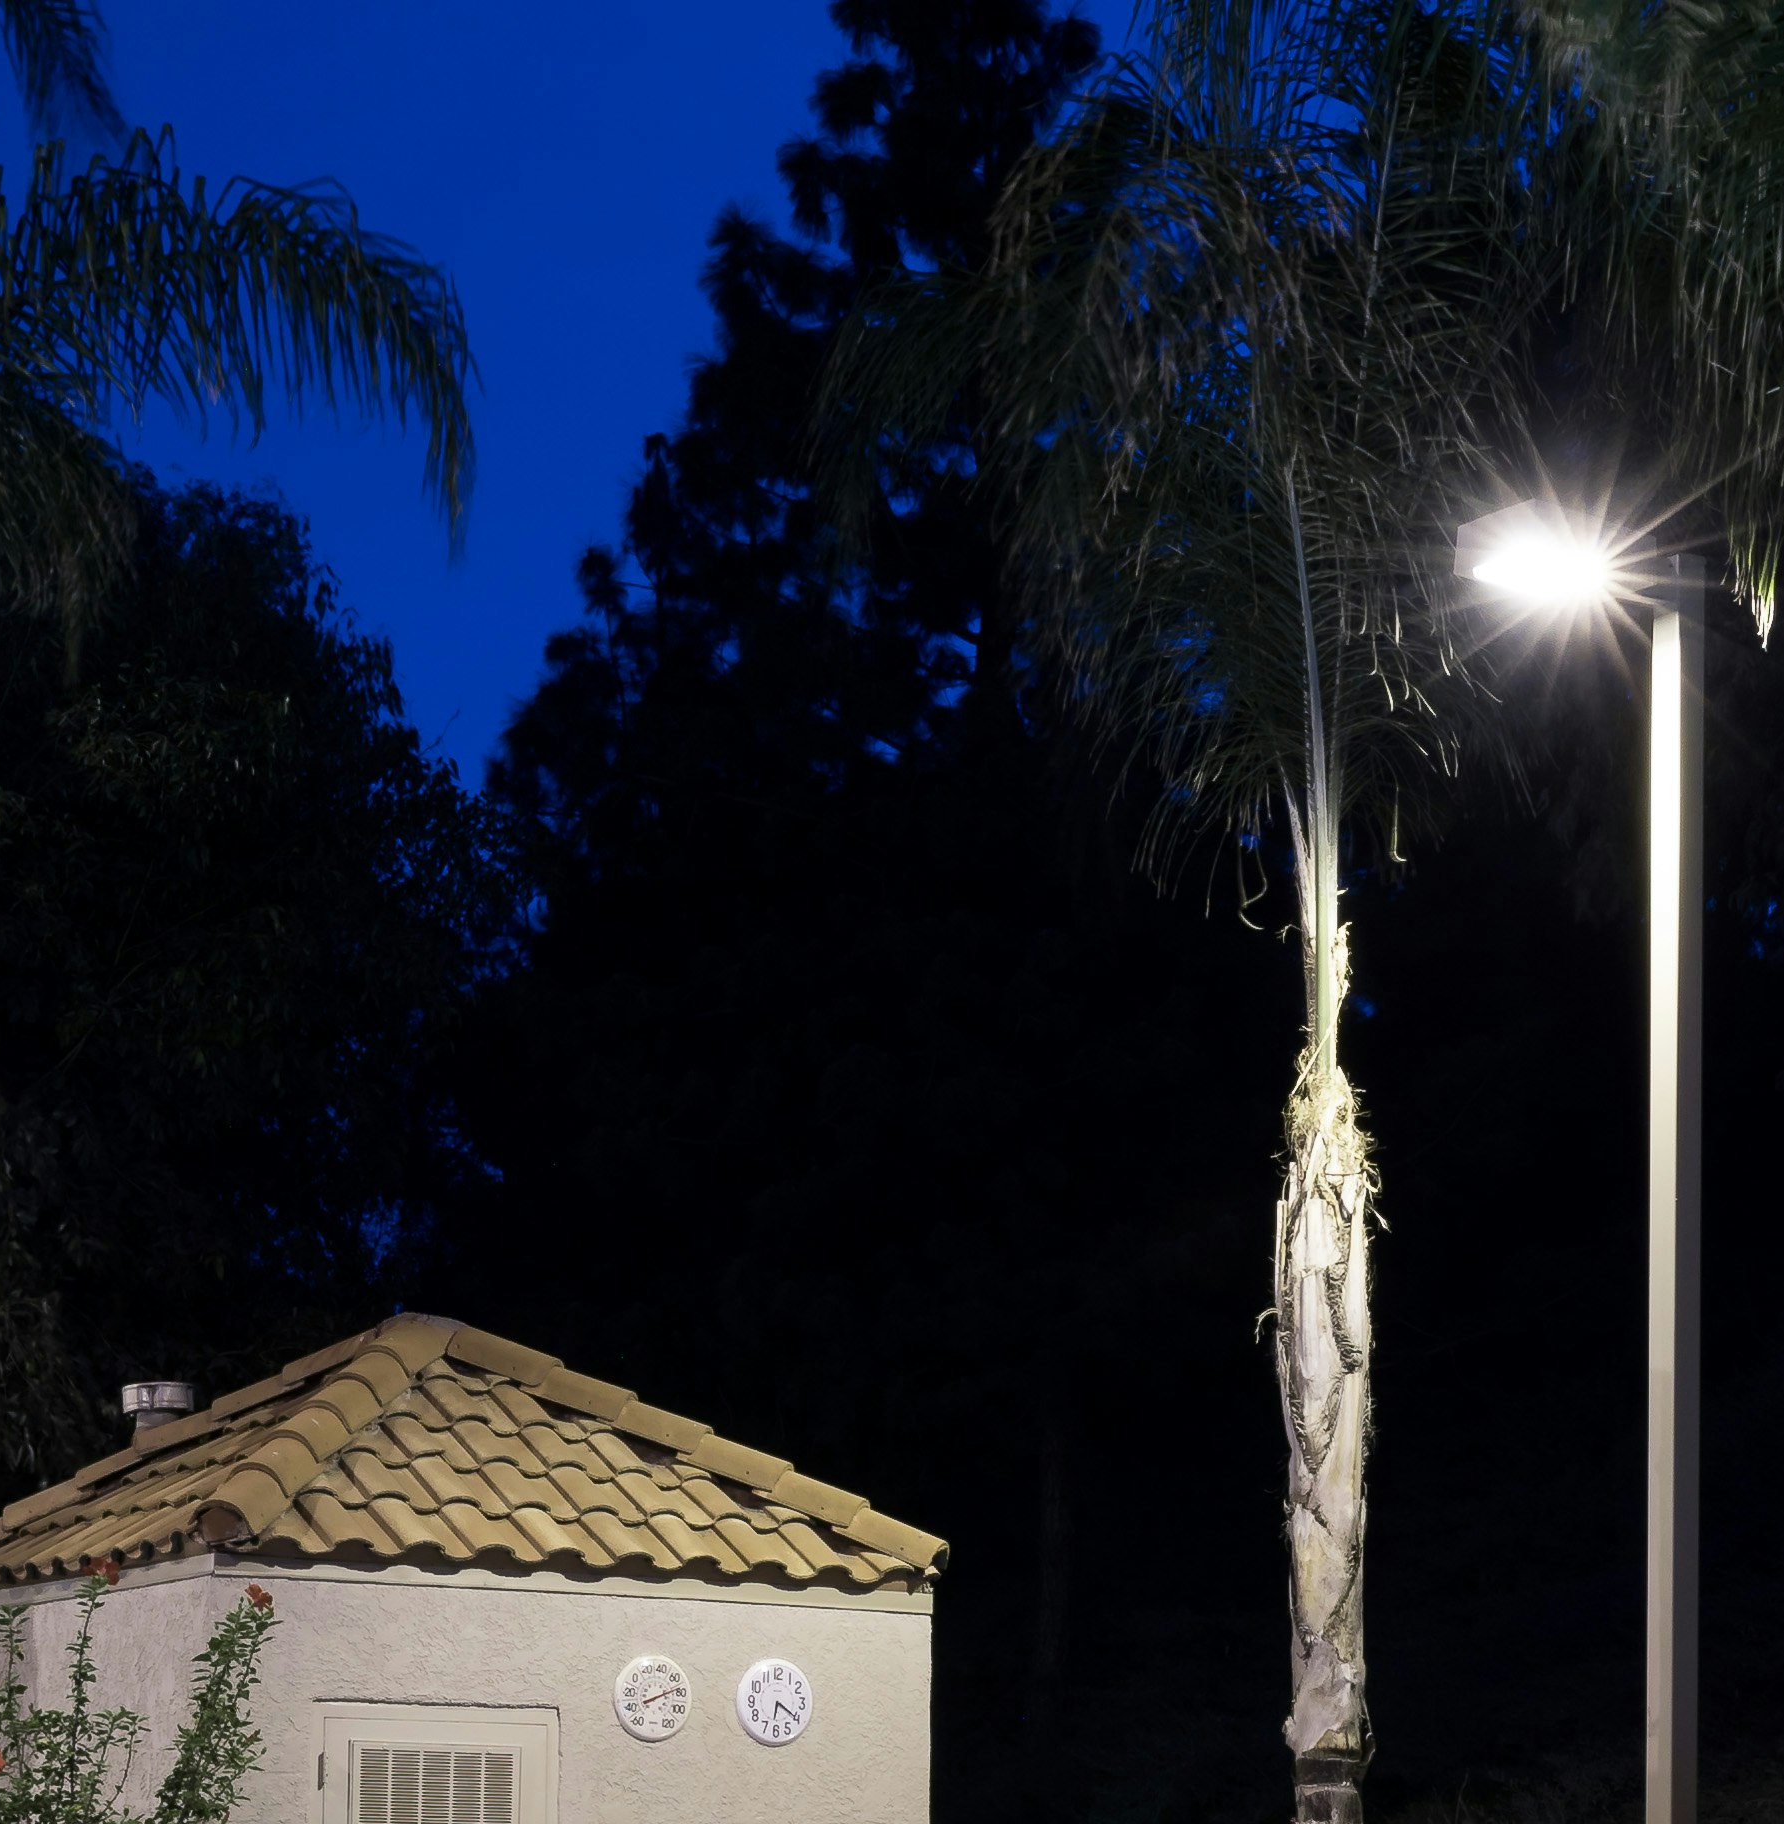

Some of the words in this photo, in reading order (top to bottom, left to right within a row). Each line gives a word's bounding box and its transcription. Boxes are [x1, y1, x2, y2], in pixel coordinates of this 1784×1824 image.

[642, 1665, 653, 1674] 20
[656, 1664, 667, 1674] 40
[774, 1667, 783, 1680] 12
[632, 1673, 638, 1683] 0
[669, 1673, 680, 1683] 60
[763, 1670, 769, 1683] 11
[675, 1688, 687, 1698] 80
[752, 1680, 761, 1693] 10
[795, 1681, 802, 1694] 2
[748, 1695, 755, 1708] 9
[799, 1697, 806, 1710] 3
[672, 1704, 685, 1714] 100
[752, 1709, 759, 1722] 8
[662, 1719, 675, 1729] 120
[793, 1712, 800, 1725] 4
[762, 1721, 769, 1734] 7
[773, 1725, 780, 1738] 6
[784, 1722, 791, 1735] 5
